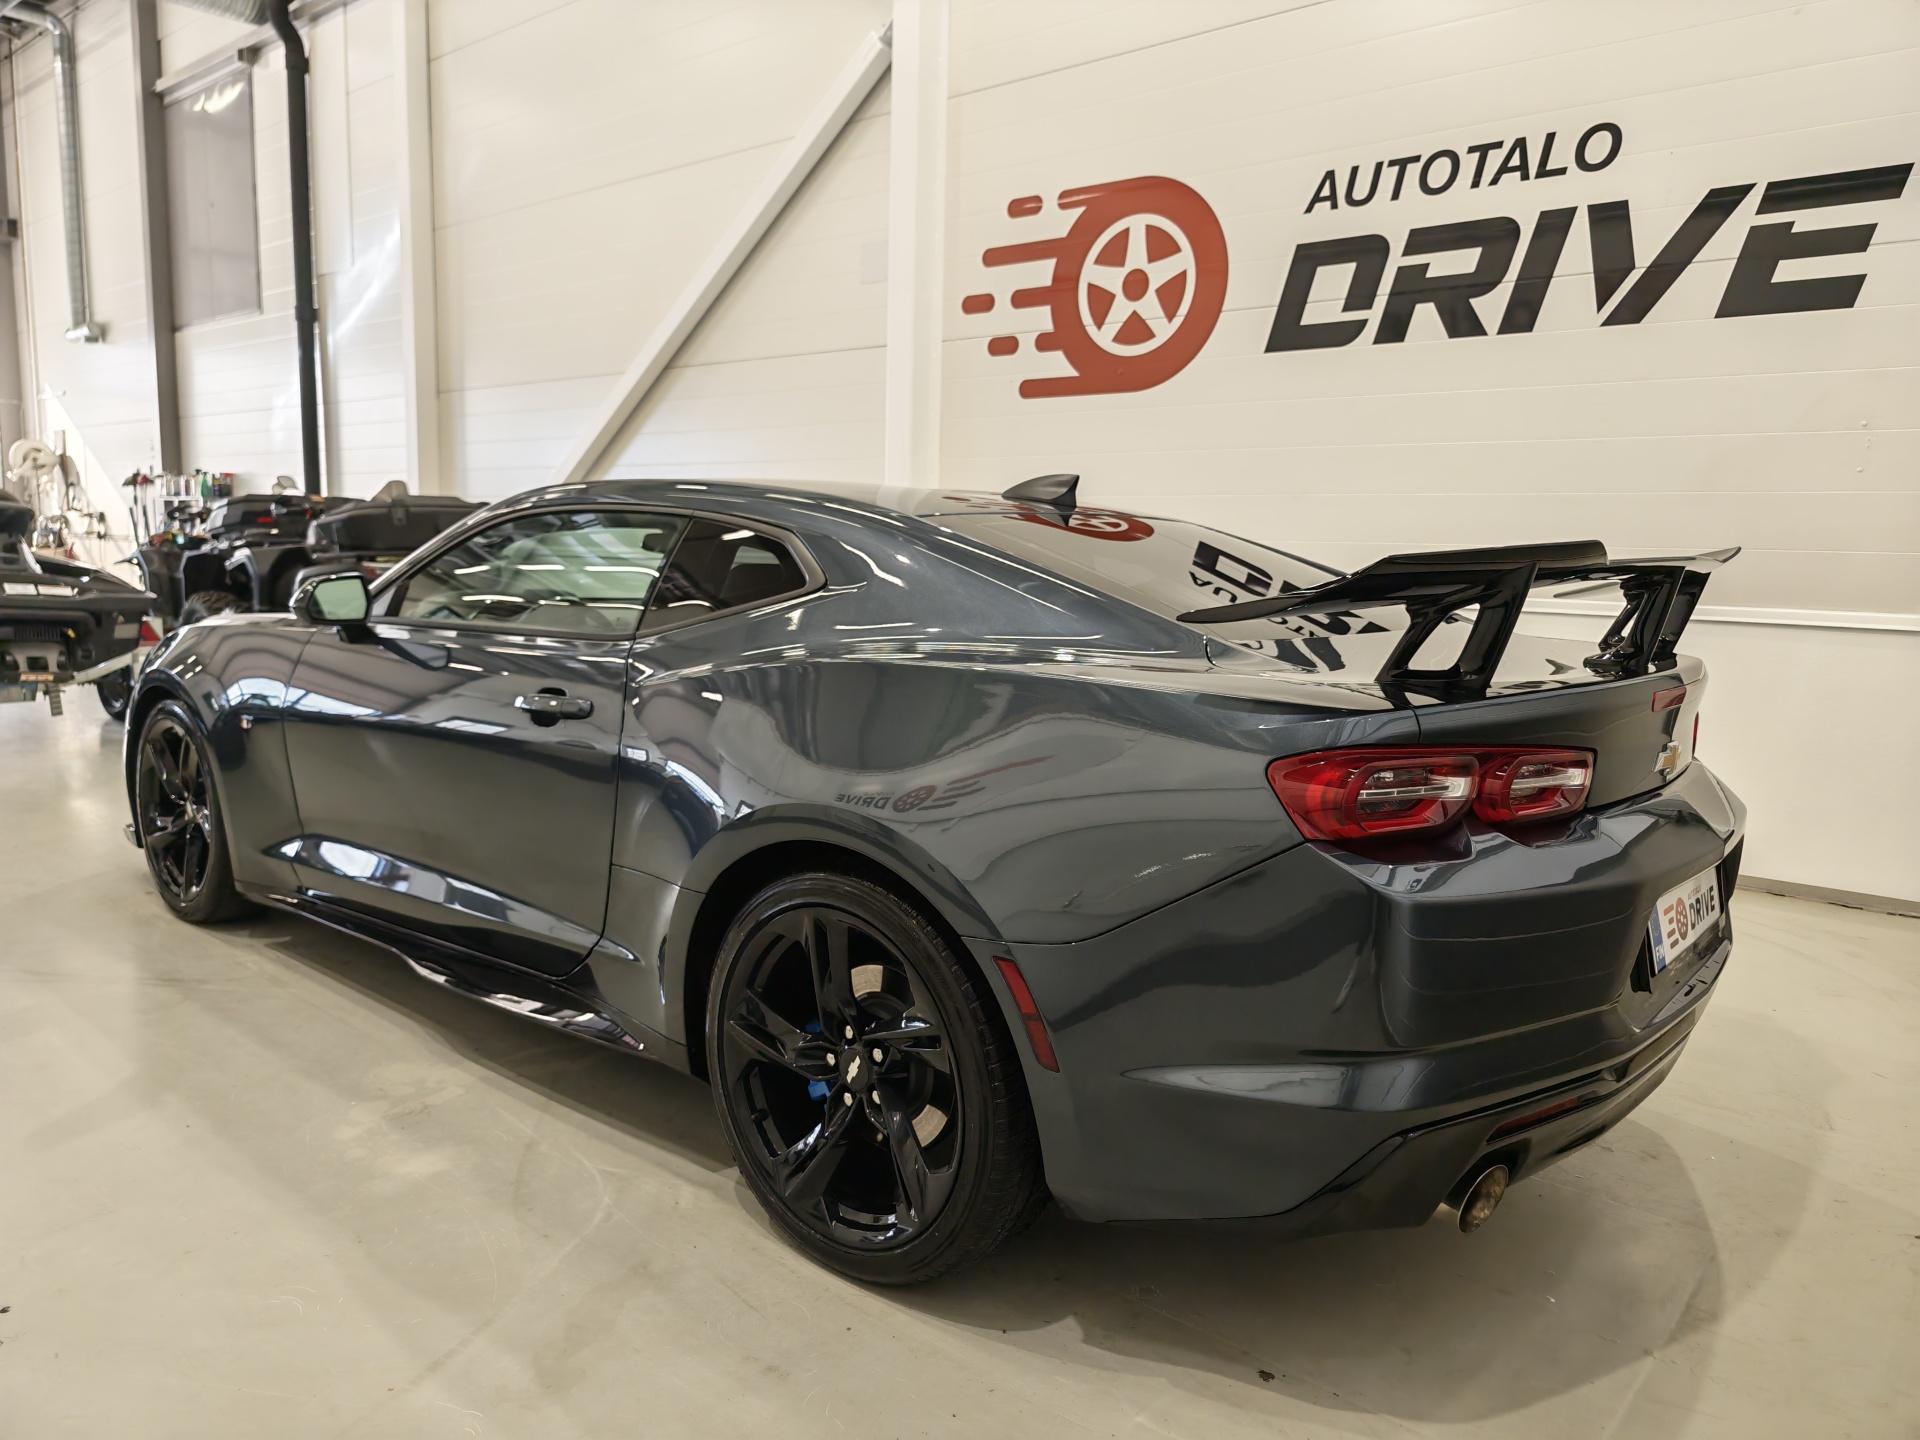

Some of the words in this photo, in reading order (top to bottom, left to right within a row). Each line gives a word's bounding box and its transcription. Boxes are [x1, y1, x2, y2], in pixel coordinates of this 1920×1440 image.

[1304, 122, 1623, 214] AUTOTALO
[1263, 162, 1915, 354] DRIVE
[1689, 885, 1715, 930] DRIVE
